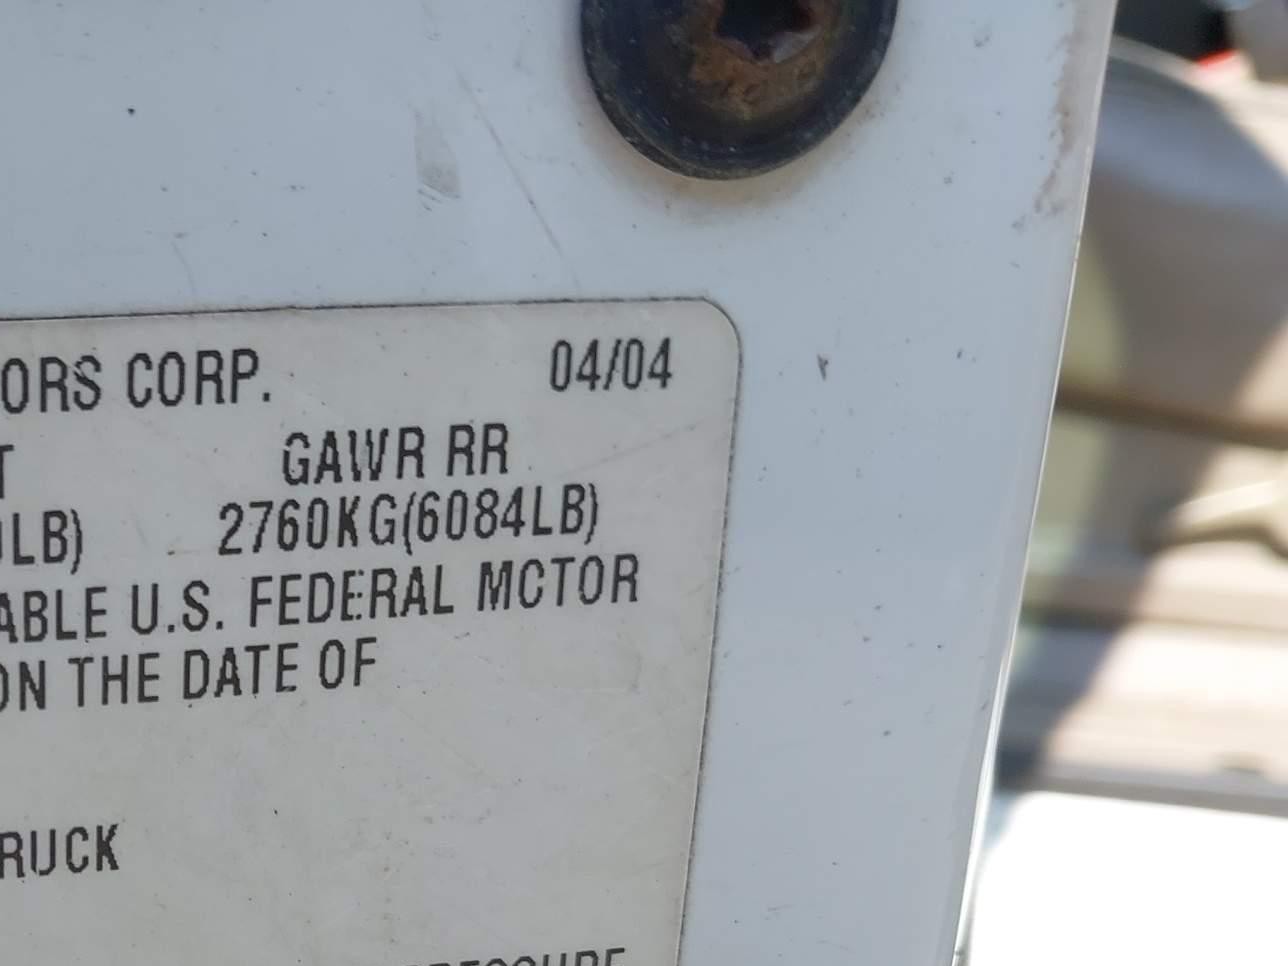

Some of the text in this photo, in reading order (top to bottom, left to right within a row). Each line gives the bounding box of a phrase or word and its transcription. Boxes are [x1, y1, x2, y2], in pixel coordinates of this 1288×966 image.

[127, 348, 270, 408] CORP.
[550, 337, 672, 392] 04/04
[283, 423, 508, 485] GAWR RR
[218, 483, 598, 555] 2760KG(6084LB)
[132, 580, 223, 635] U.S.
[250, 565, 454, 627] FEDERAL
[68, 653, 159, 707] THE
[183, 643, 298, 699] DATE
[319, 637, 377, 689] OF
